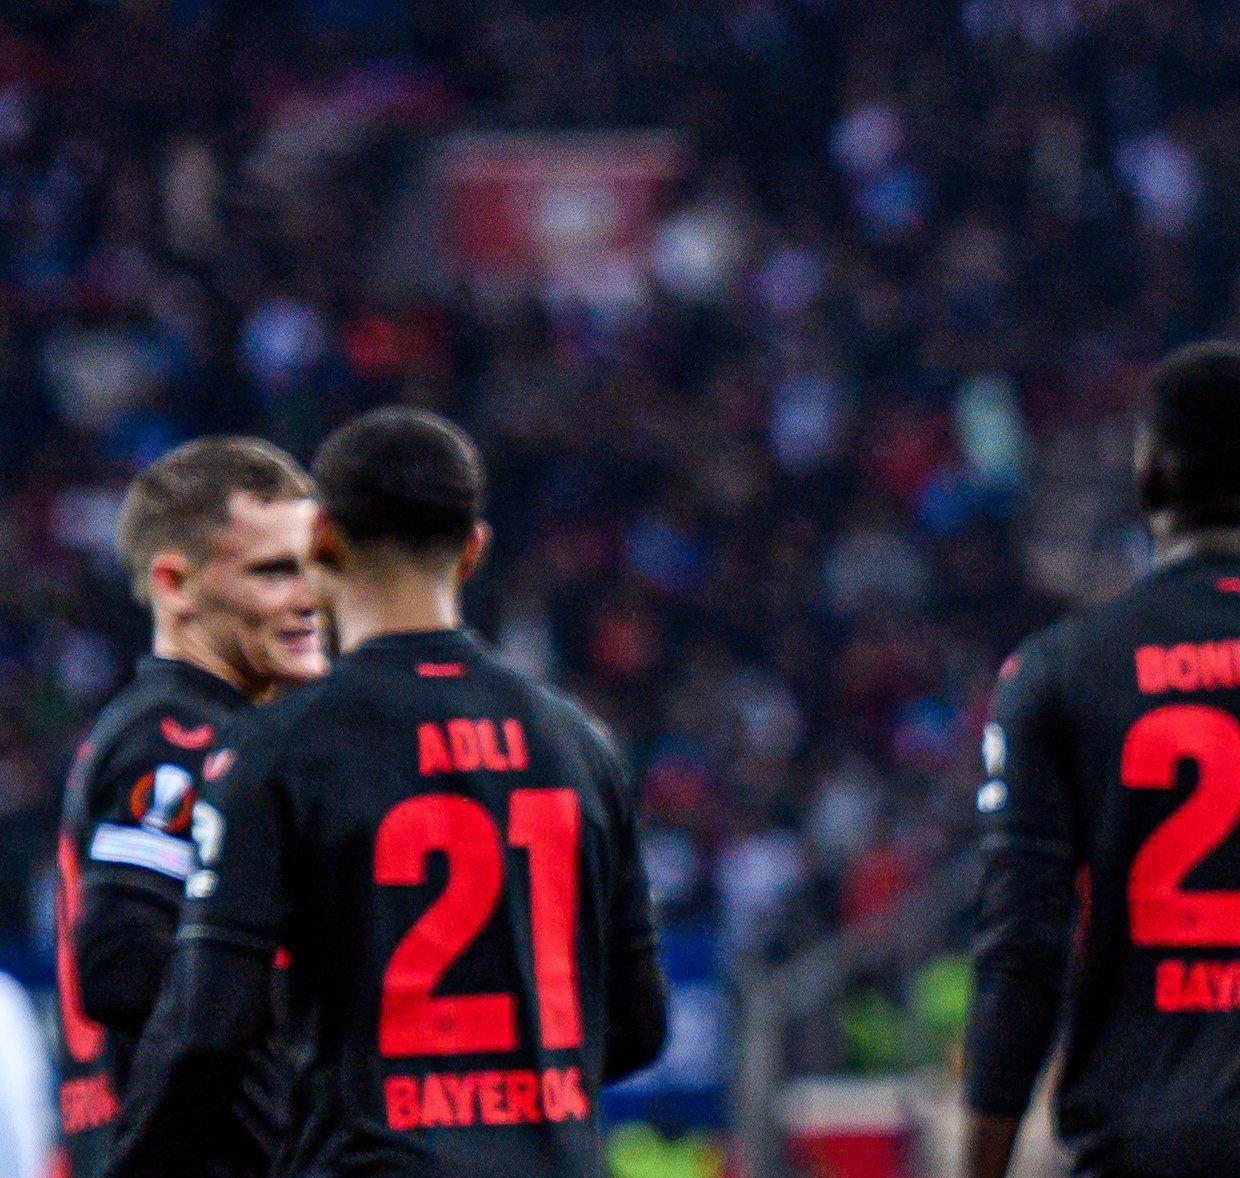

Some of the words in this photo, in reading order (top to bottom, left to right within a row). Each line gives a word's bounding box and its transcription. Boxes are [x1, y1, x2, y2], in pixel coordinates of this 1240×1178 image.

[417, 718, 528, 776] ADLI
[375, 789, 583, 1057] 21
[385, 1070, 541, 1130] BAYER
[541, 1066, 589, 1122] 04
